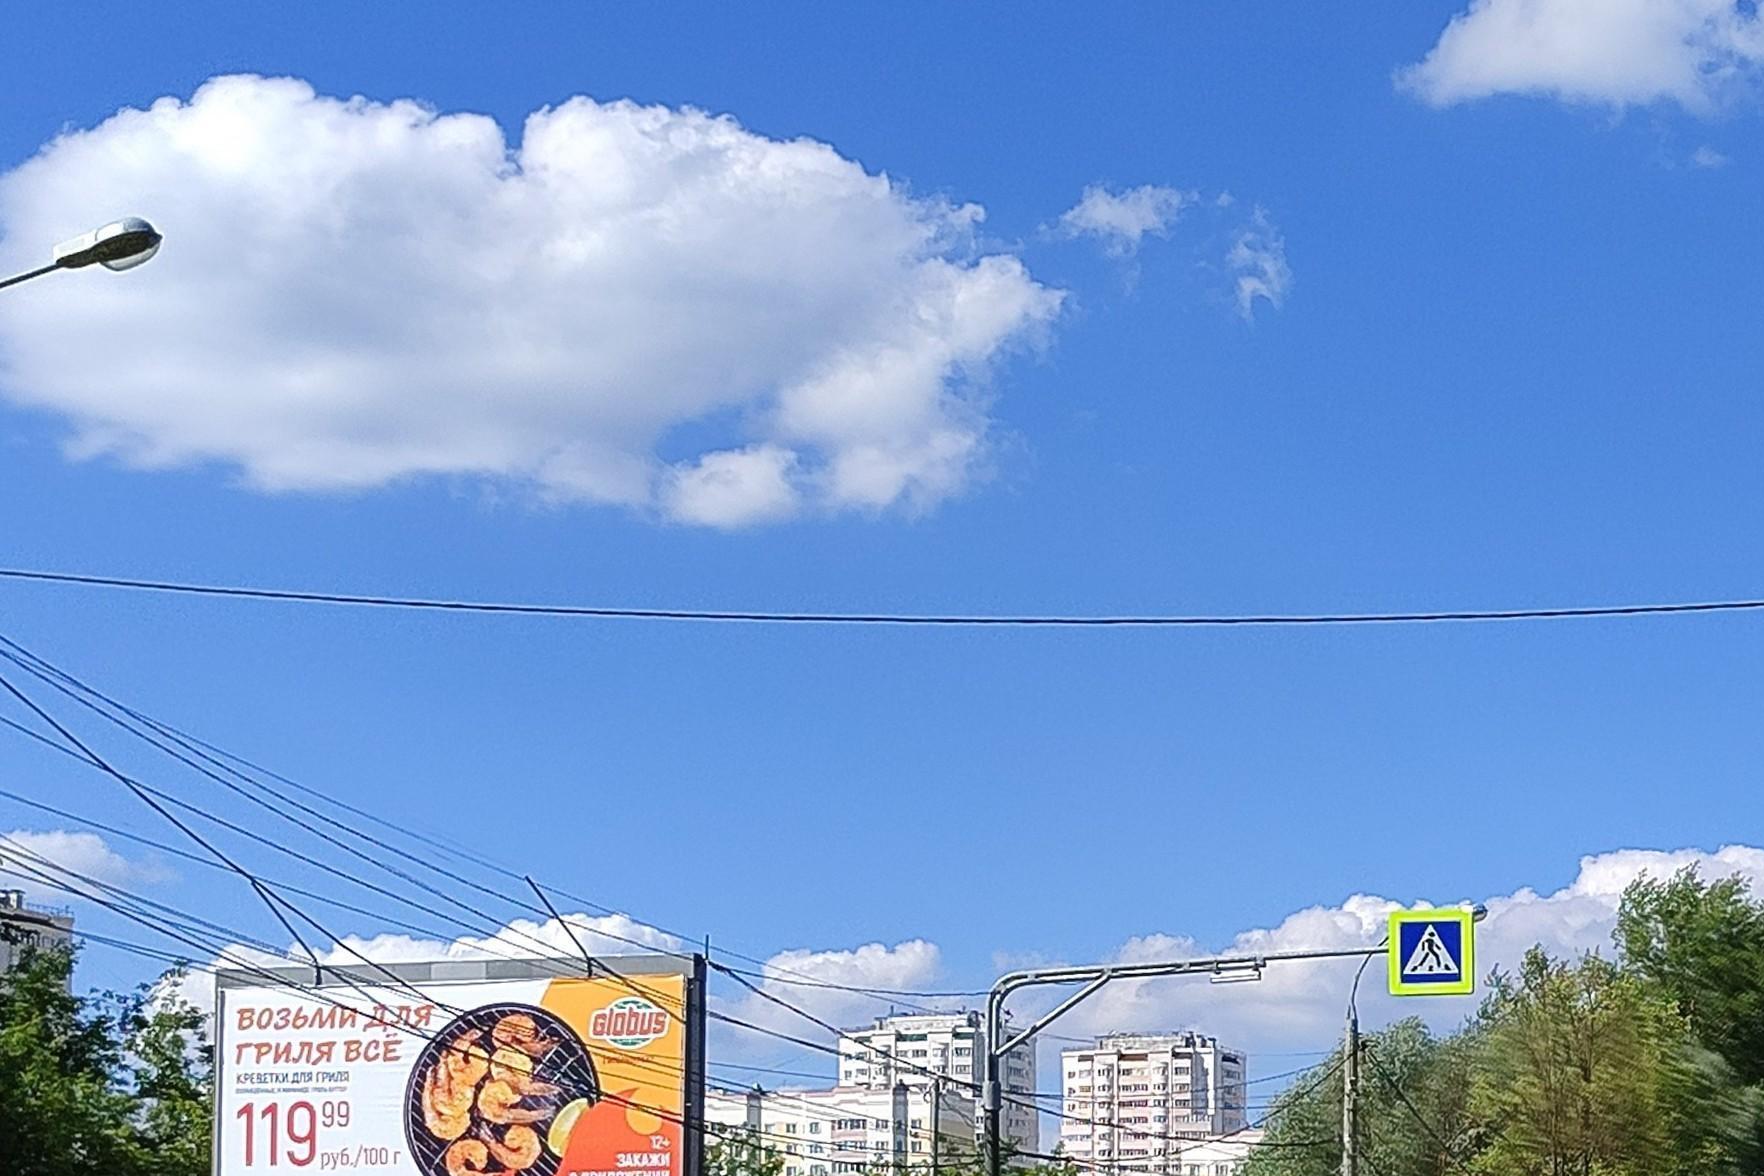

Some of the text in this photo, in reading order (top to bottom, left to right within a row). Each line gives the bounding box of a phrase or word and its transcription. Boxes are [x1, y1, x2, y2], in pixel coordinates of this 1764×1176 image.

[237, 1004, 434, 1031] ВОЗЬМИ ДЛЯ
[235, 1033, 403, 1065] ГРИЛЯ ВСЁ
[236, 1072, 289, 1084] КРЕВЕТКИ
[291, 1072, 313, 1084] ДЛЯ
[237, 1100, 350, 1167] 119 99
[616, 1152, 671, 1167] ЗАКАЖИ
